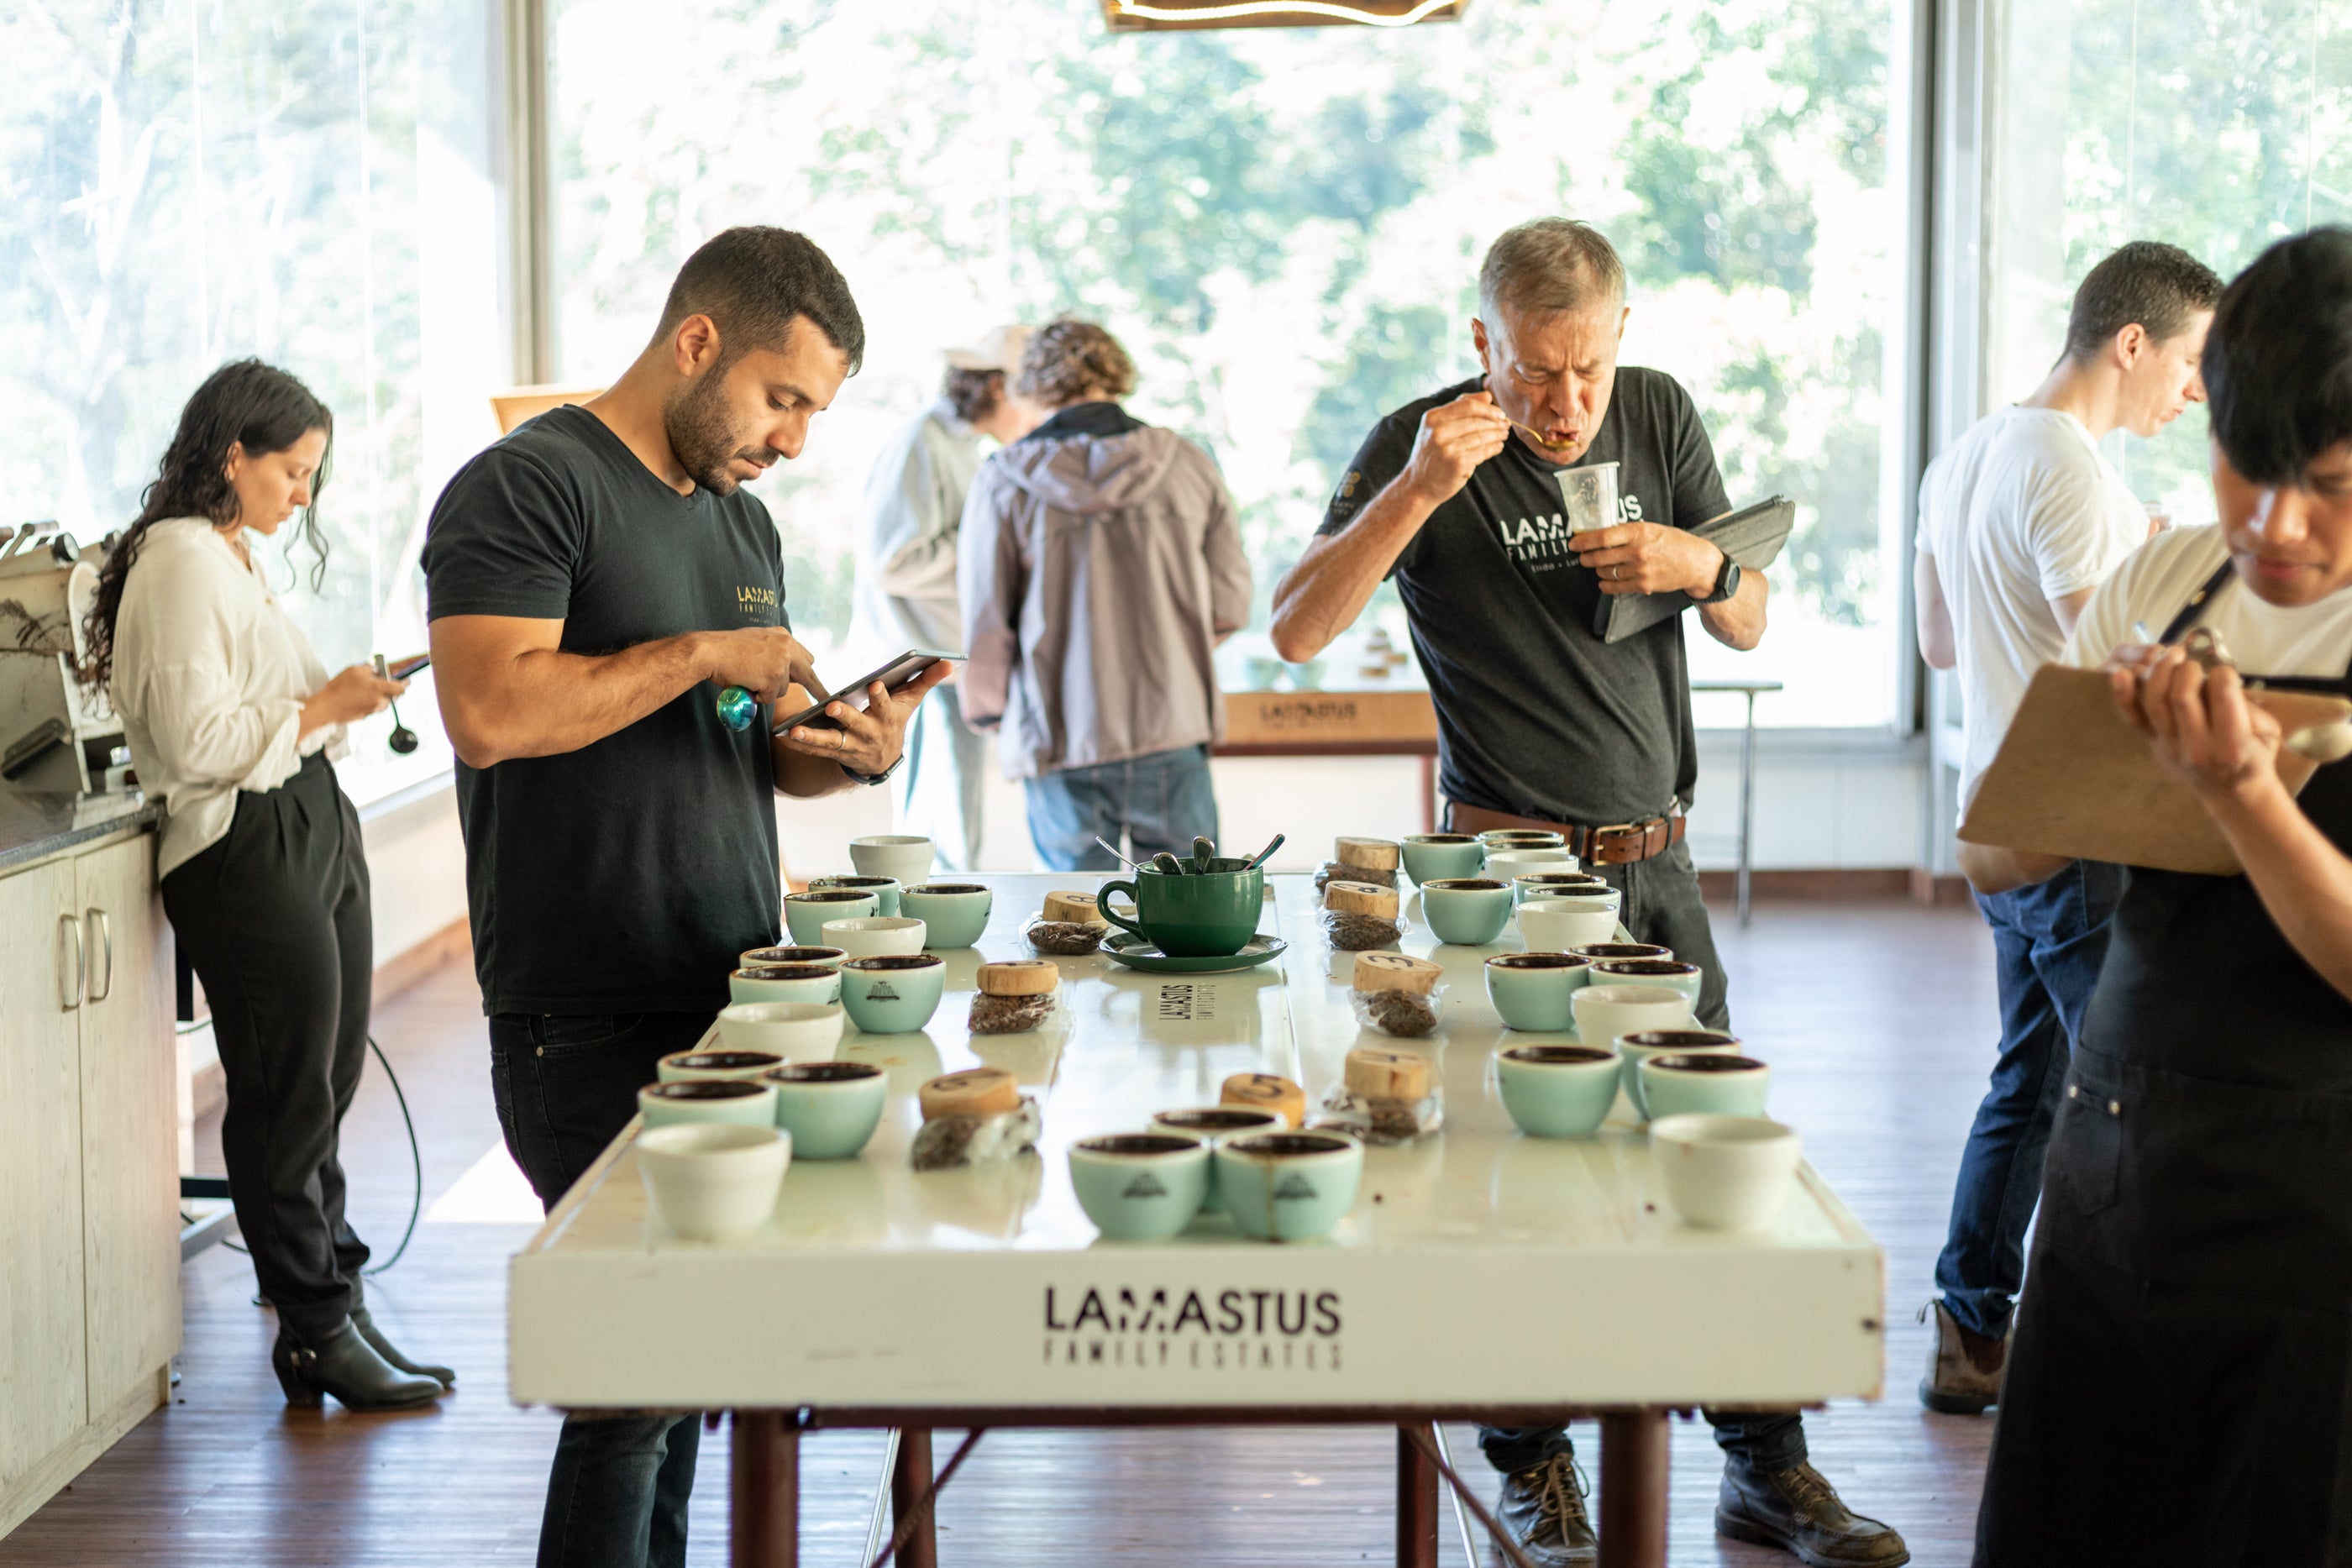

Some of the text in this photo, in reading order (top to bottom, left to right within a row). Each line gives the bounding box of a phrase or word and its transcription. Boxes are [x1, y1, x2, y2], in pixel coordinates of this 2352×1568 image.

[1500, 494, 1643, 546] LAMUS
[1506, 539, 1568, 560] FAMILY
[737, 586, 778, 608] LAMAS
[1367, 955, 1414, 968] 3
[1158, 984, 1193, 1020] LAMASTUS
[1045, 1286, 1341, 1335] LAMASTUS
[1043, 1339, 1341, 1371] FAMILY ESTATES
